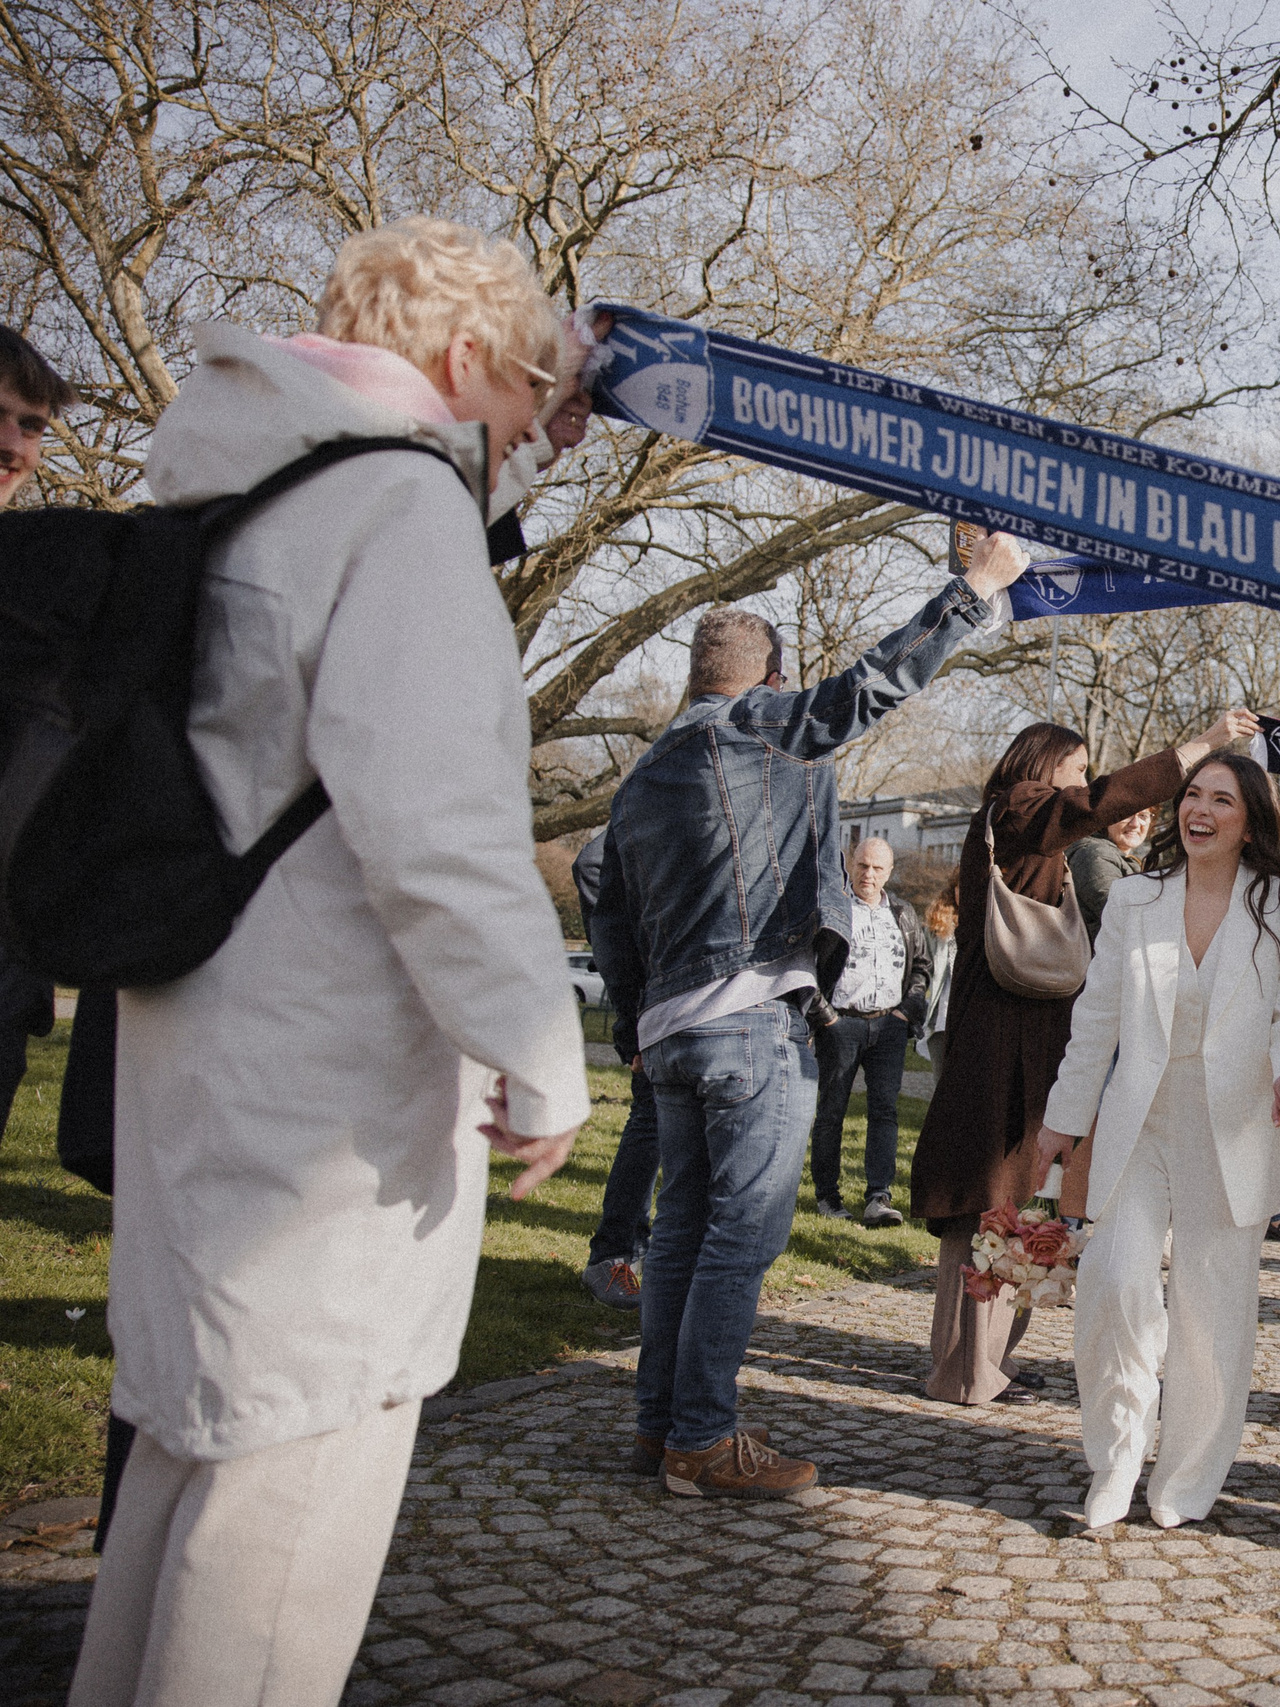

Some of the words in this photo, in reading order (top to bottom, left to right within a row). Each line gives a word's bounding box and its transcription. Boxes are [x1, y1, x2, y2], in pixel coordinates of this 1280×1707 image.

[828, 366, 886, 393] TIEF
[891, 381, 923, 404] IM
[935, 394, 1054, 442] WESTEN,
[1060, 429, 1160, 469] DAHER
[732, 375, 924, 472] BOCHUMER
[931, 426, 1086, 520] JUNGEN
[1095, 471, 1137, 534] IN
[1146, 485, 1256, 564] BLAU
[1042, 531, 1151, 570] STEHEN
[1158, 558, 1200, 581] ZU
[1207, 569, 1268, 600] DIR!
